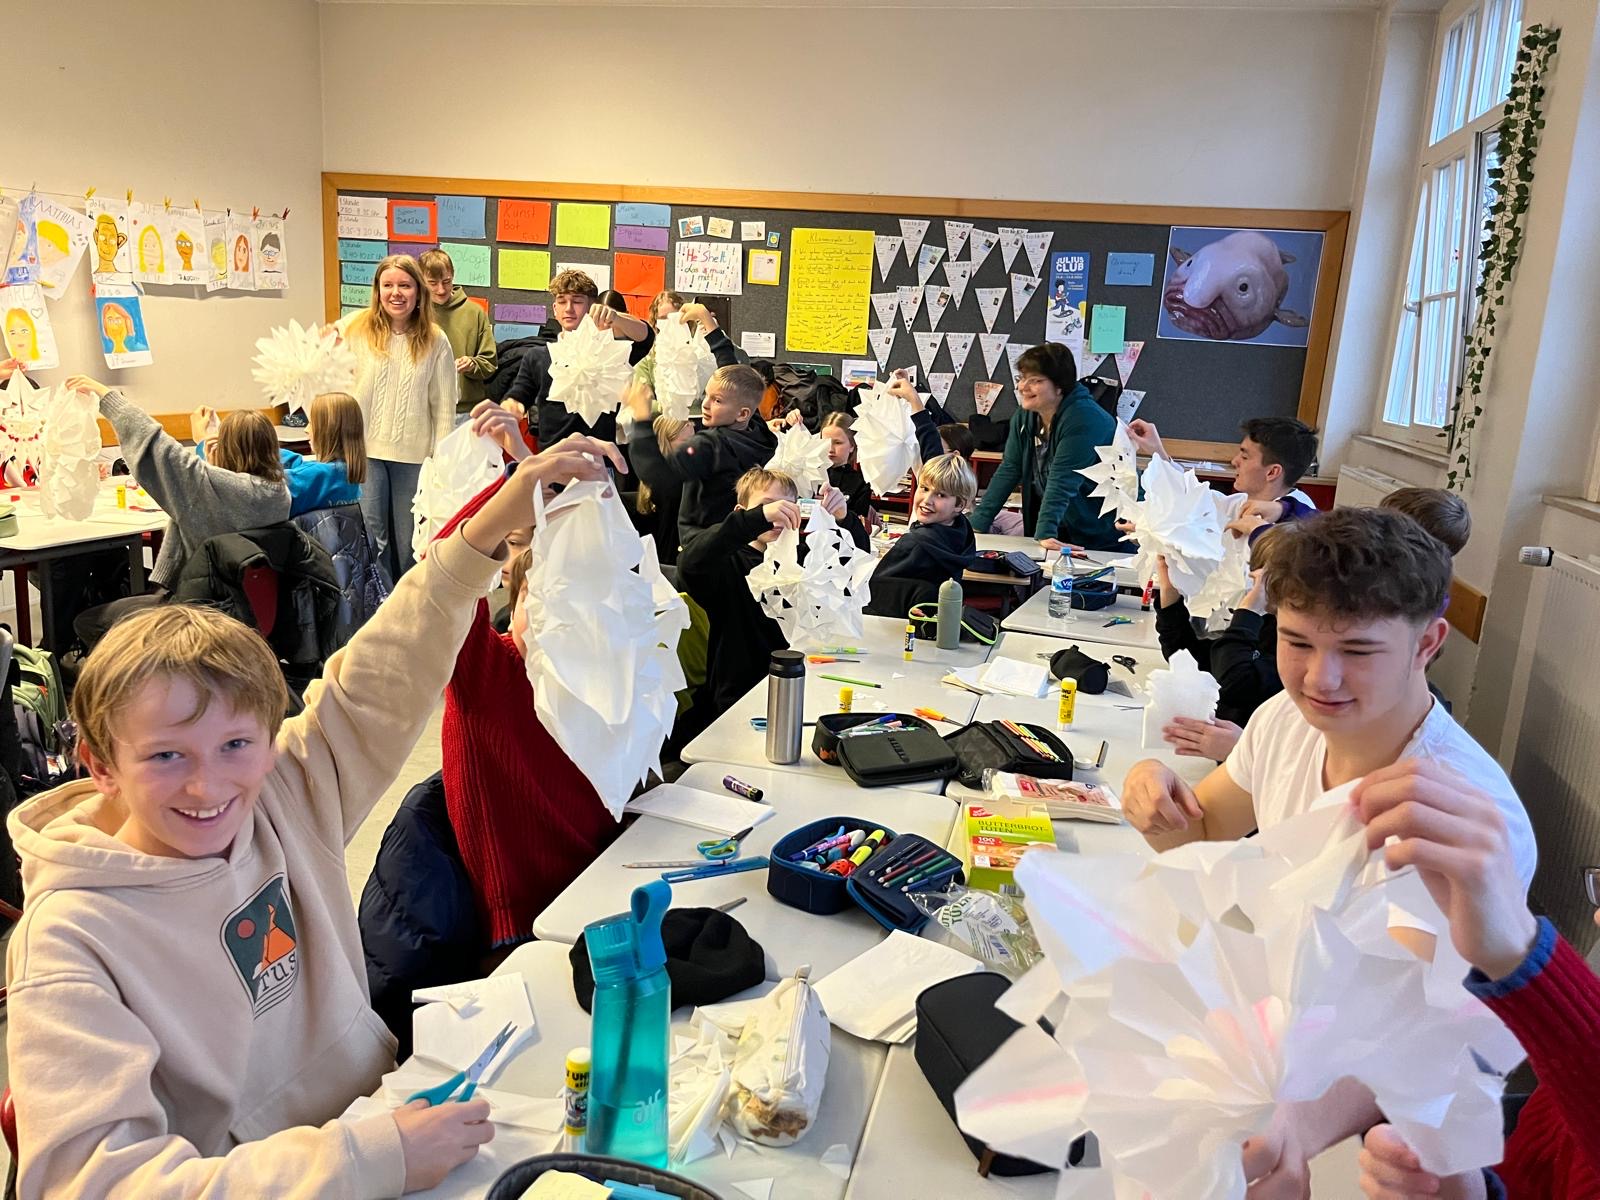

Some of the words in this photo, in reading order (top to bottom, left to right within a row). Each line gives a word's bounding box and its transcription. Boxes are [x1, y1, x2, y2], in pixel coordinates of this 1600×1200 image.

[503, 203, 536, 218] Kunst
[686, 248, 699, 263] He
[1056, 256, 1084, 265] JULIUS
[1056, 263, 1084, 273] CLUB
[978, 820, 1049, 832] BUTTERBROT-
